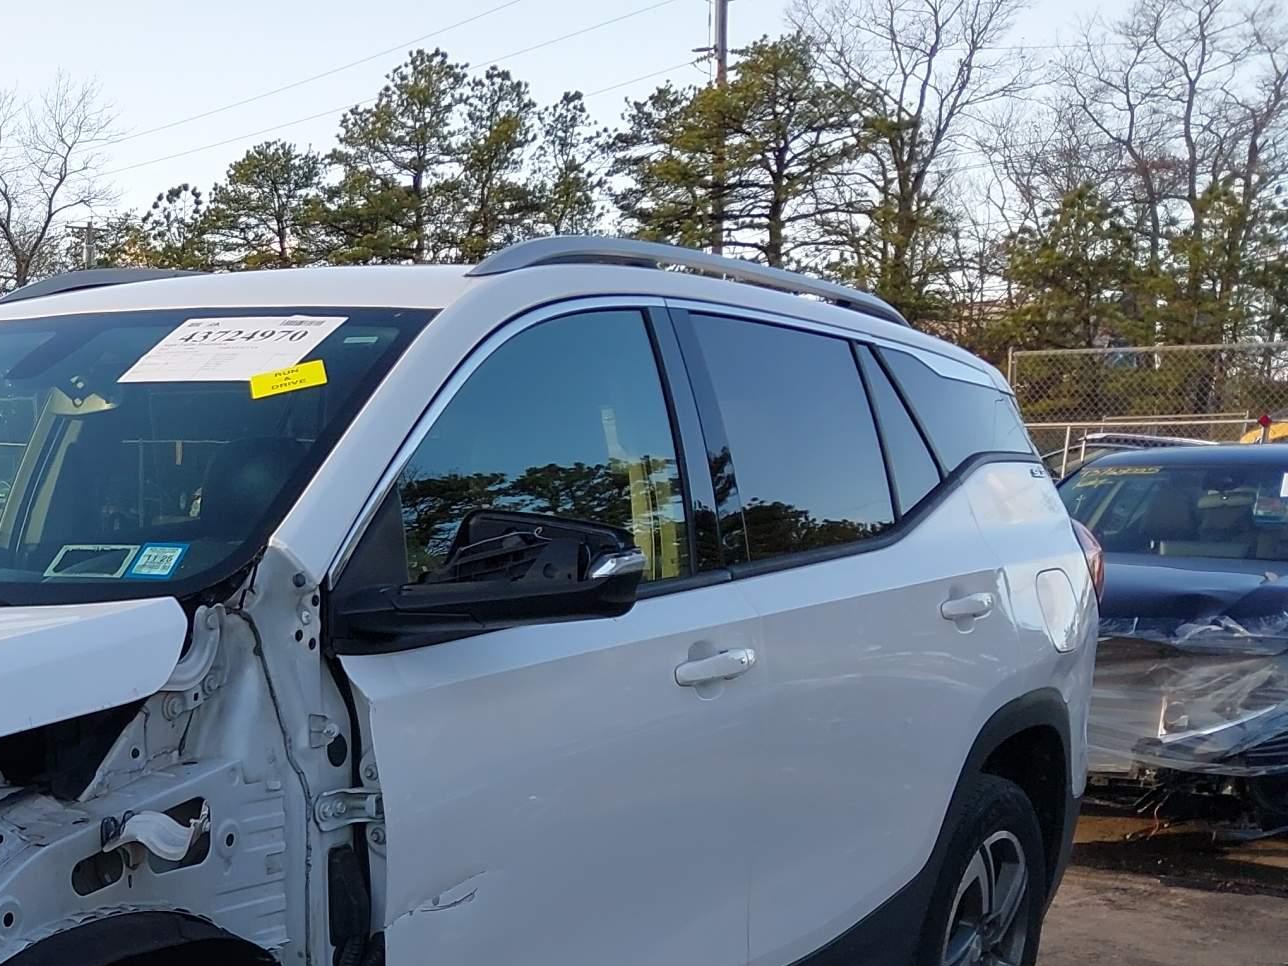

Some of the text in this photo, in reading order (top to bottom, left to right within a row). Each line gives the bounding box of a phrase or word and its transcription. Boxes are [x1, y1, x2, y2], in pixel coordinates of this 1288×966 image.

[178, 329, 310, 343] 43724970
[274, 369, 299, 377] RUN
[271, 378, 306, 390] DRIVE
